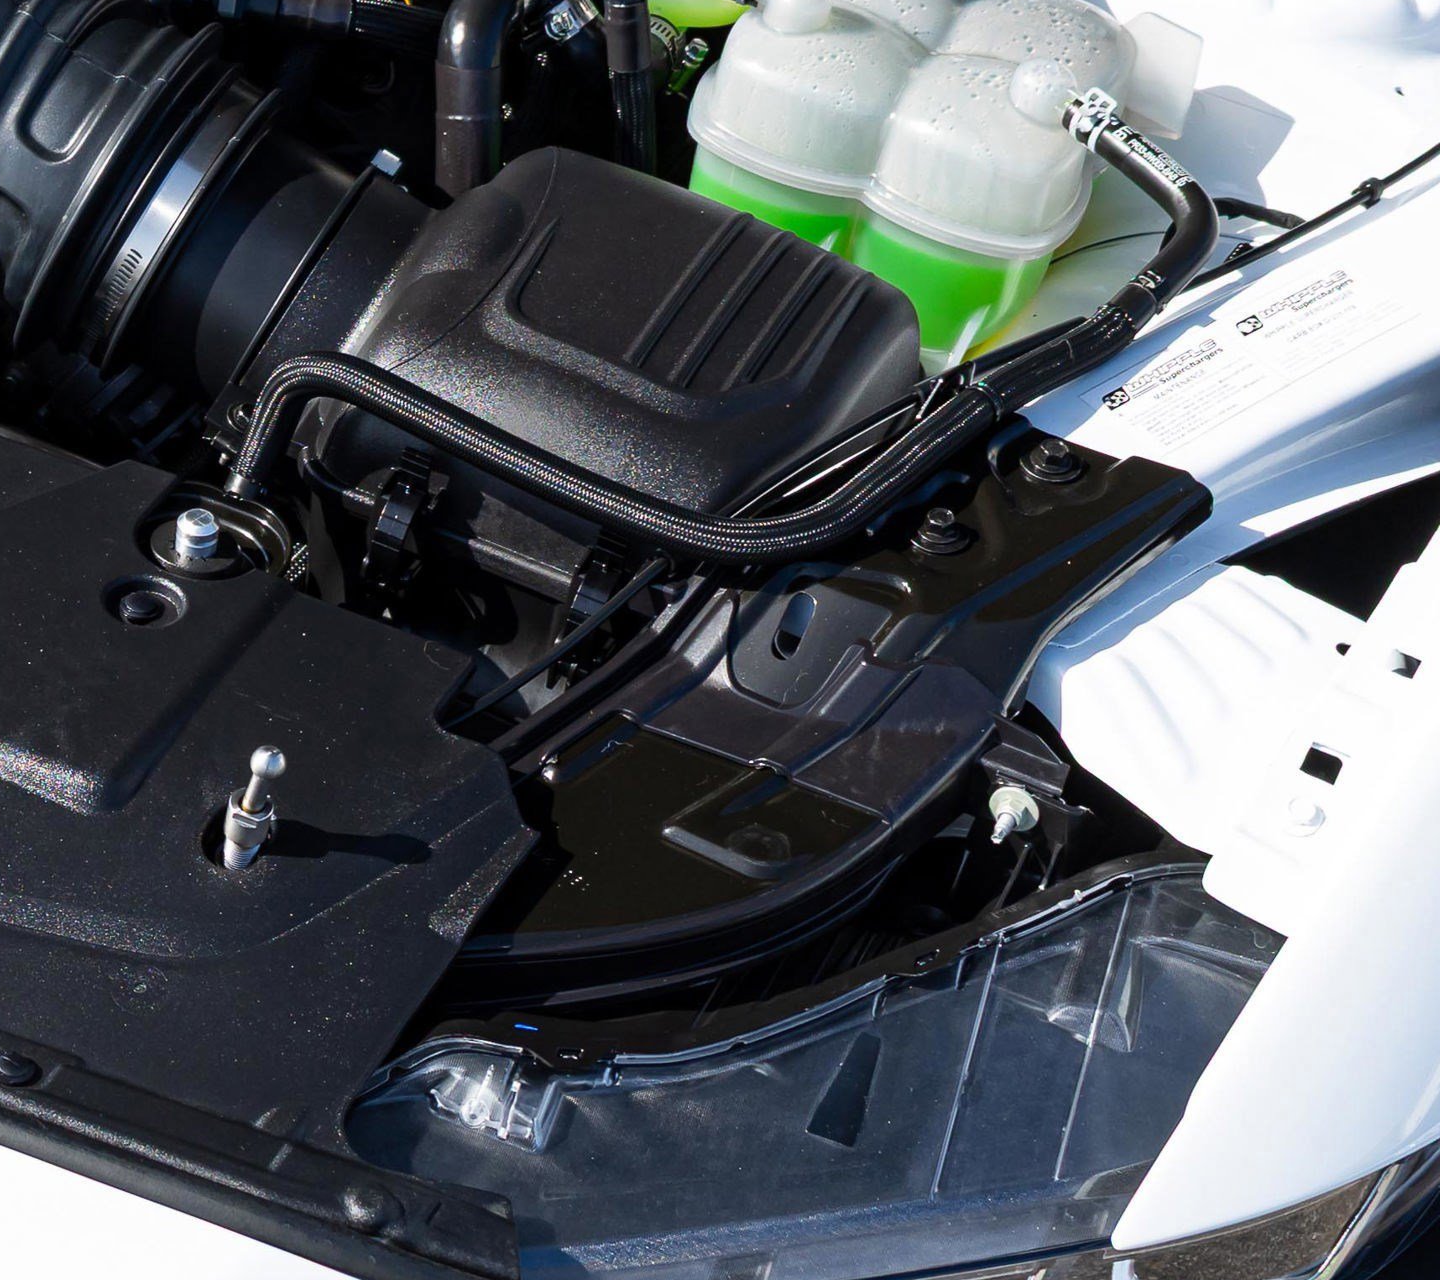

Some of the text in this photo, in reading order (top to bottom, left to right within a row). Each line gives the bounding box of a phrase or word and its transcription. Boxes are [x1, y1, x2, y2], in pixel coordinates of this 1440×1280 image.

[1291, 278, 1355, 313] Superchargers
[1125, 338, 1217, 393] WHIPPLE
[1159, 346, 1224, 384] Superchargers
